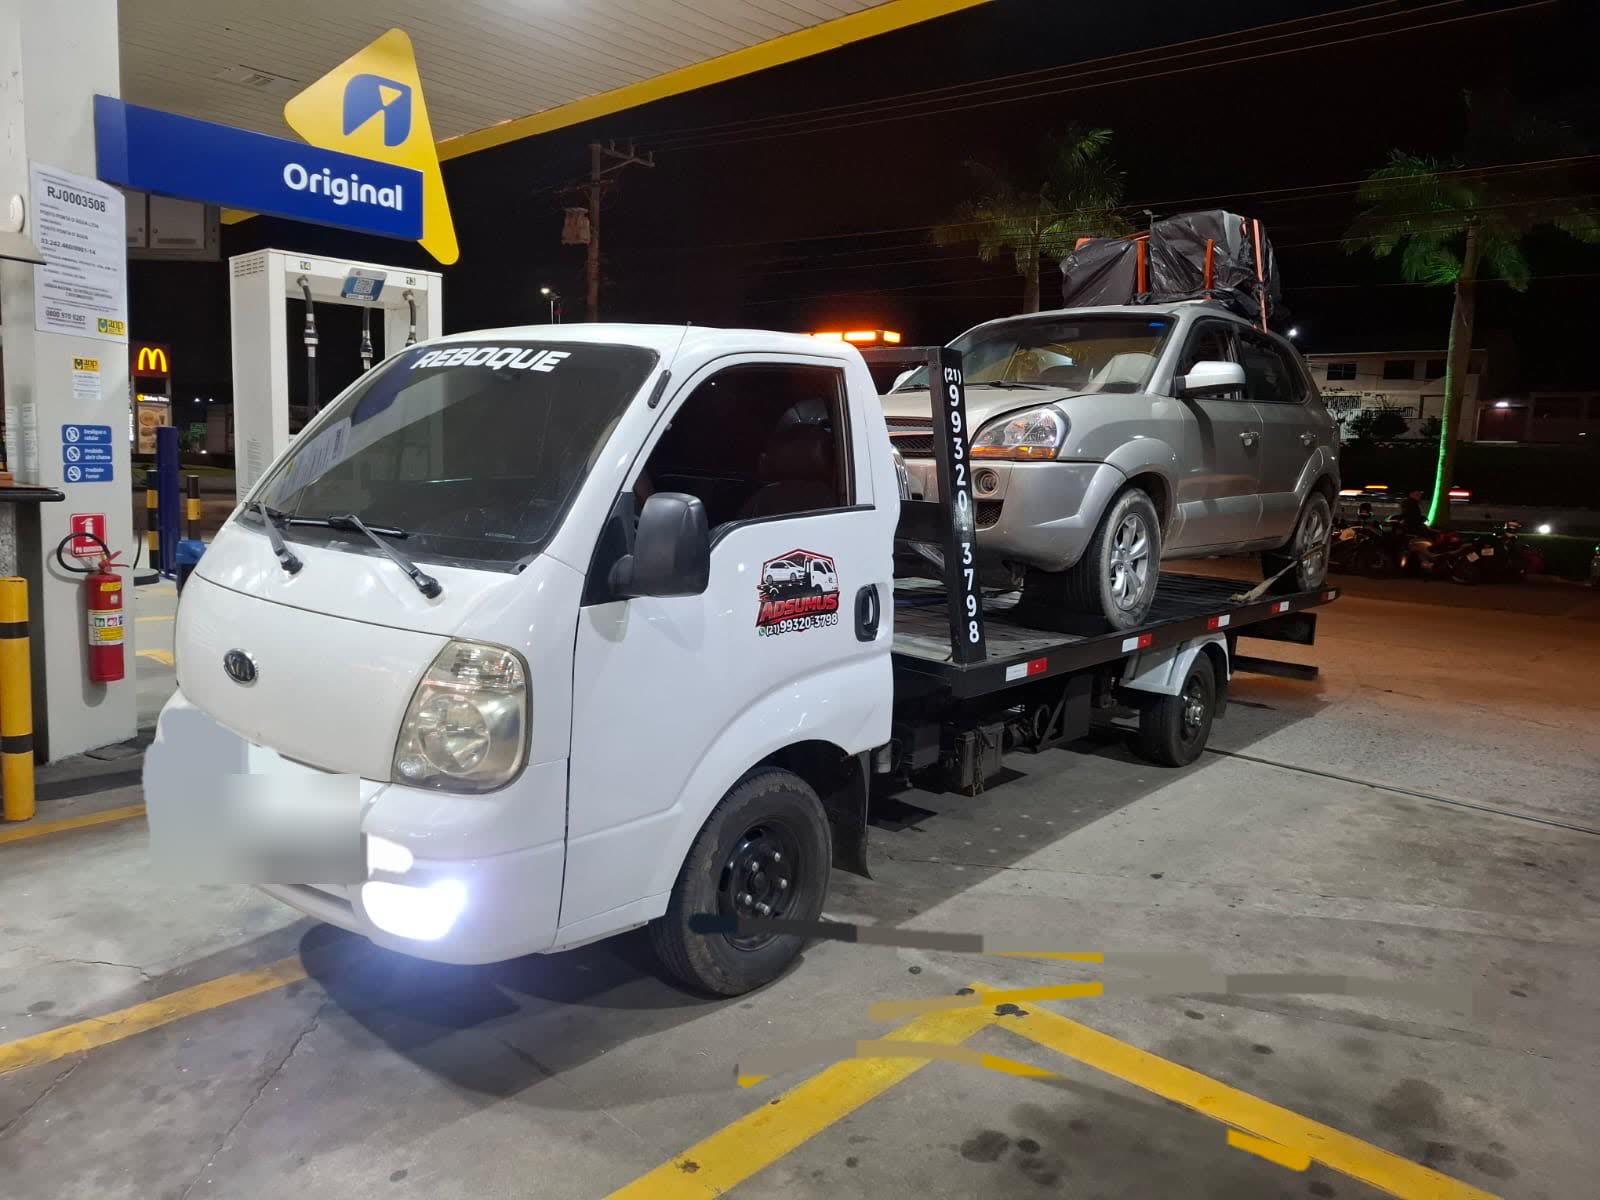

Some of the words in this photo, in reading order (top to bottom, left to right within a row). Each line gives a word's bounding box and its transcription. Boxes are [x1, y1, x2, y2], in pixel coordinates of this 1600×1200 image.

[47, 186, 106, 213] RJ0003508
[283, 163, 403, 211] Original
[410, 347, 571, 372] REBOQUE
[944, 367, 962, 385] (21)
[760, 593, 839, 622] ADSUMUS
